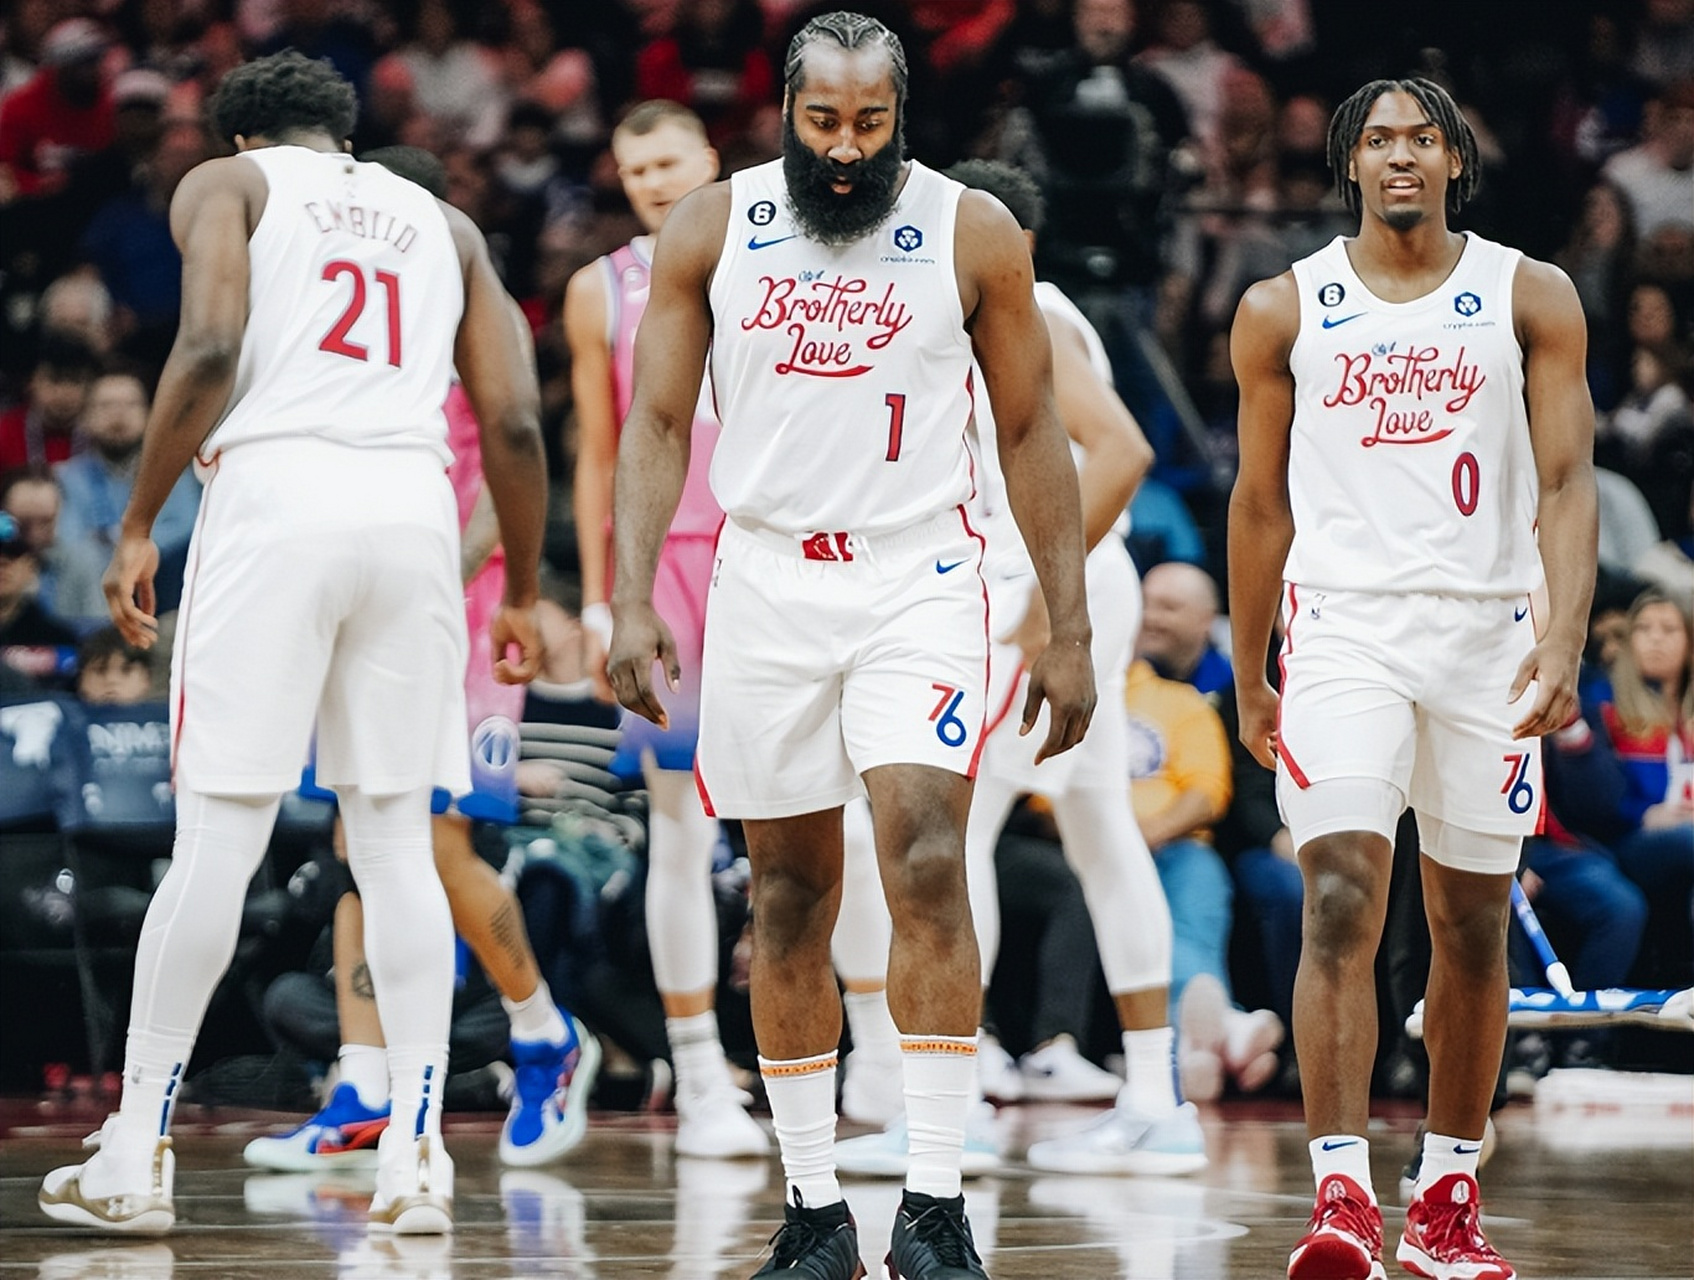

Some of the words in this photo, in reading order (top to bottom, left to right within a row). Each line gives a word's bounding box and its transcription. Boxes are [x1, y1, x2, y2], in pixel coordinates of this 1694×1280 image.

[303, 200, 418, 253] EBIID
[753, 203, 771, 223] 6
[318, 260, 401, 368] 21
[741, 275, 913, 350] Brotherly
[1324, 285, 1341, 305] 6
[775, 323, 876, 378] Love
[1323, 345, 1486, 413] Brotherly
[884, 392, 906, 461] 1
[1361, 397, 1456, 448] Love
[1452, 451, 1480, 517] 0
[928, 683, 967, 747] 76
[1500, 753, 1534, 815] 76
